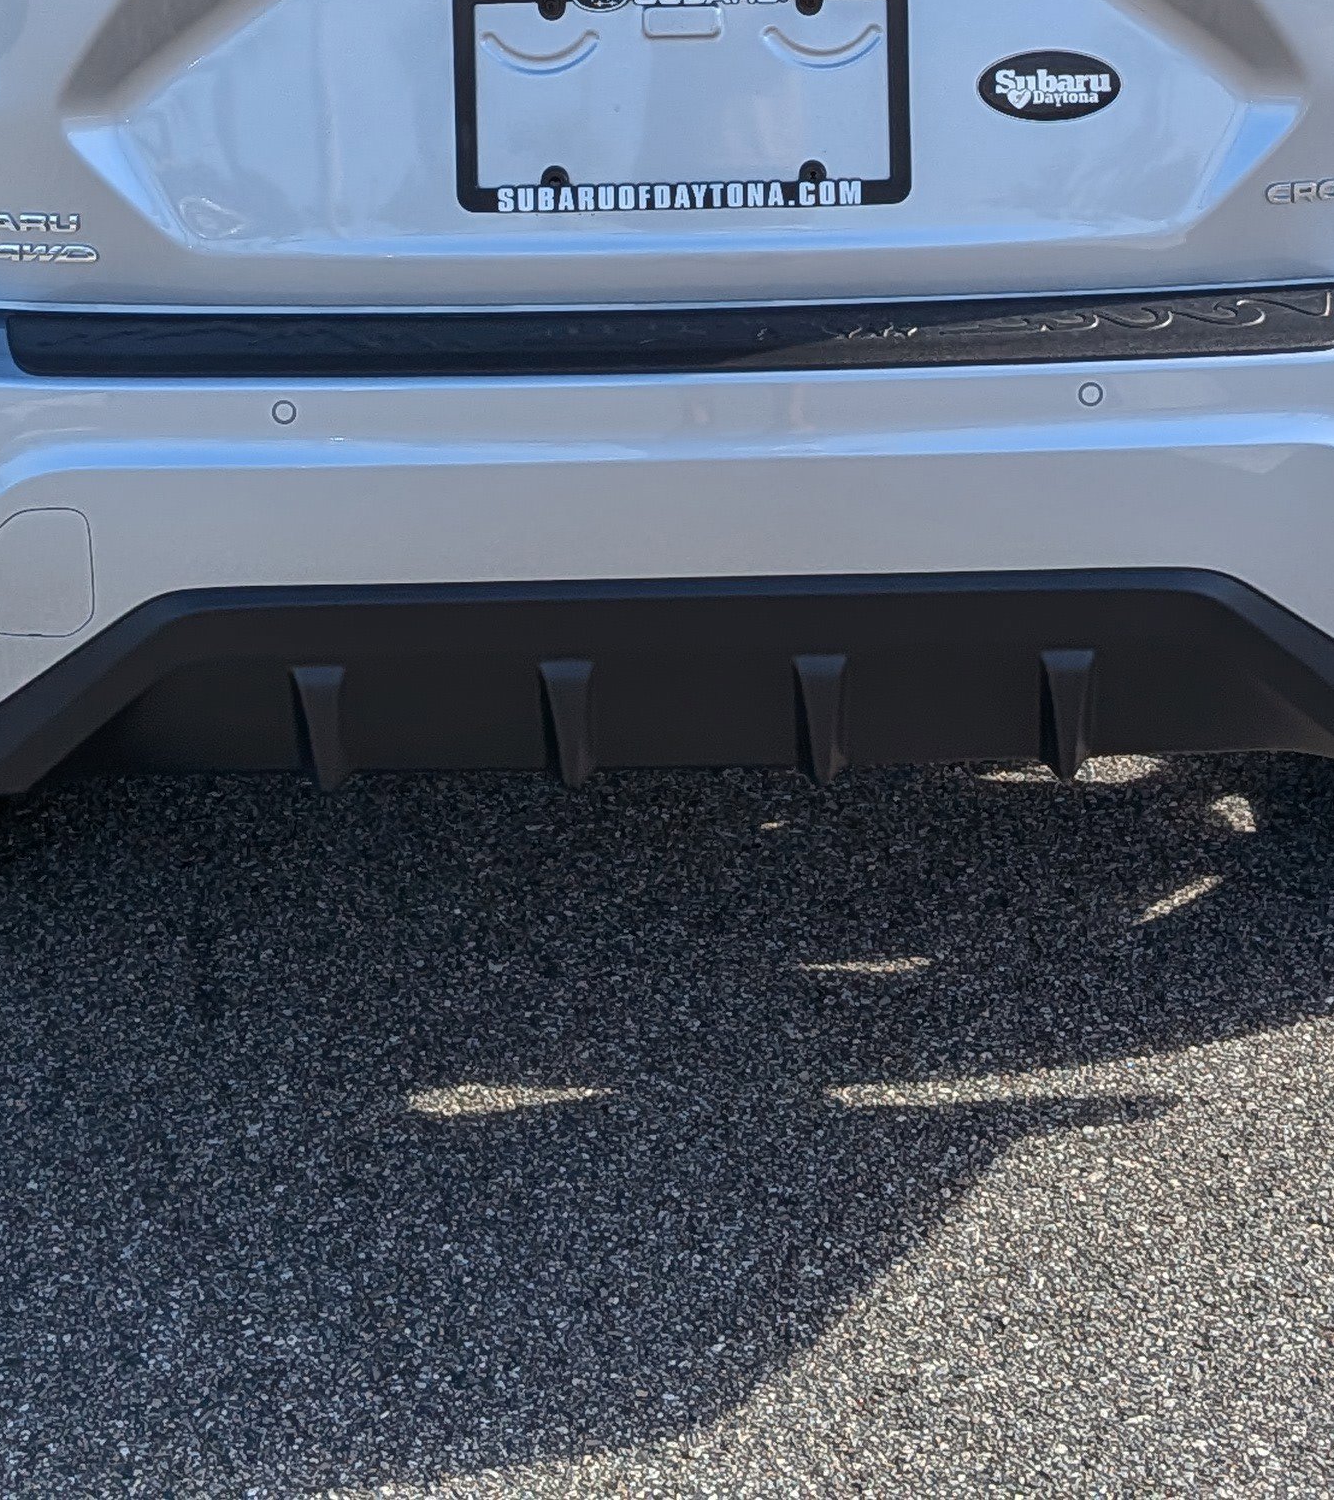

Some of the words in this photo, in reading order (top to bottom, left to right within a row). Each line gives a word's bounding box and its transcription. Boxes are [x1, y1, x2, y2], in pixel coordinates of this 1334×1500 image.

[995, 68, 1112, 94] Subaru
[1032, 90, 1099, 107] Daytona
[497, 180, 863, 212] SUBARUOFDAYTONA.COM
